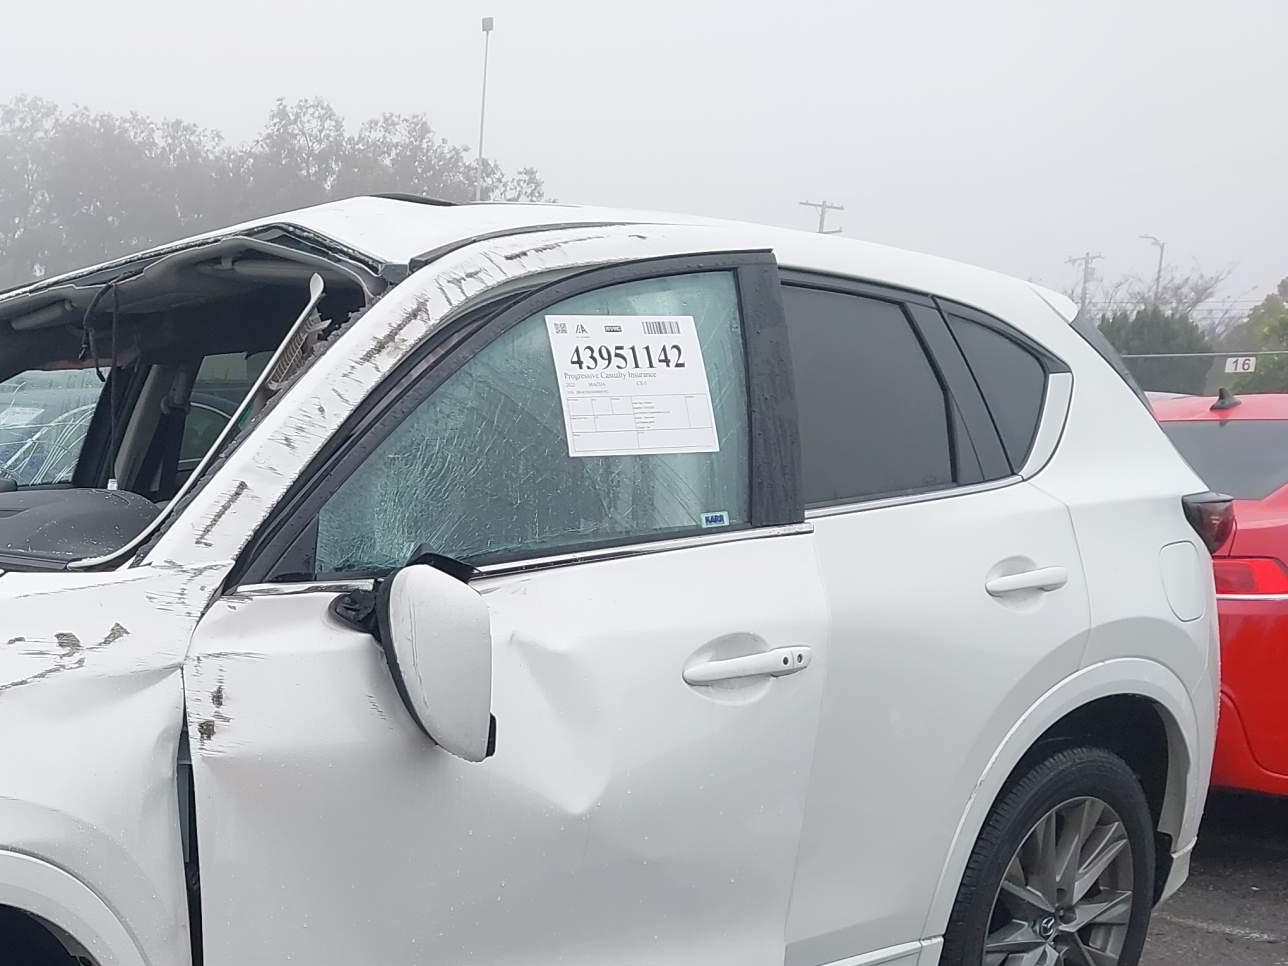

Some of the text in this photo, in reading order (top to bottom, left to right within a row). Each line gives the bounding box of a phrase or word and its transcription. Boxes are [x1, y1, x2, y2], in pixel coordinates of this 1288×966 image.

[570, 344, 686, 370] 43951142
[1232, 358, 1251, 371] 16
[628, 371, 657, 379] Insurance
